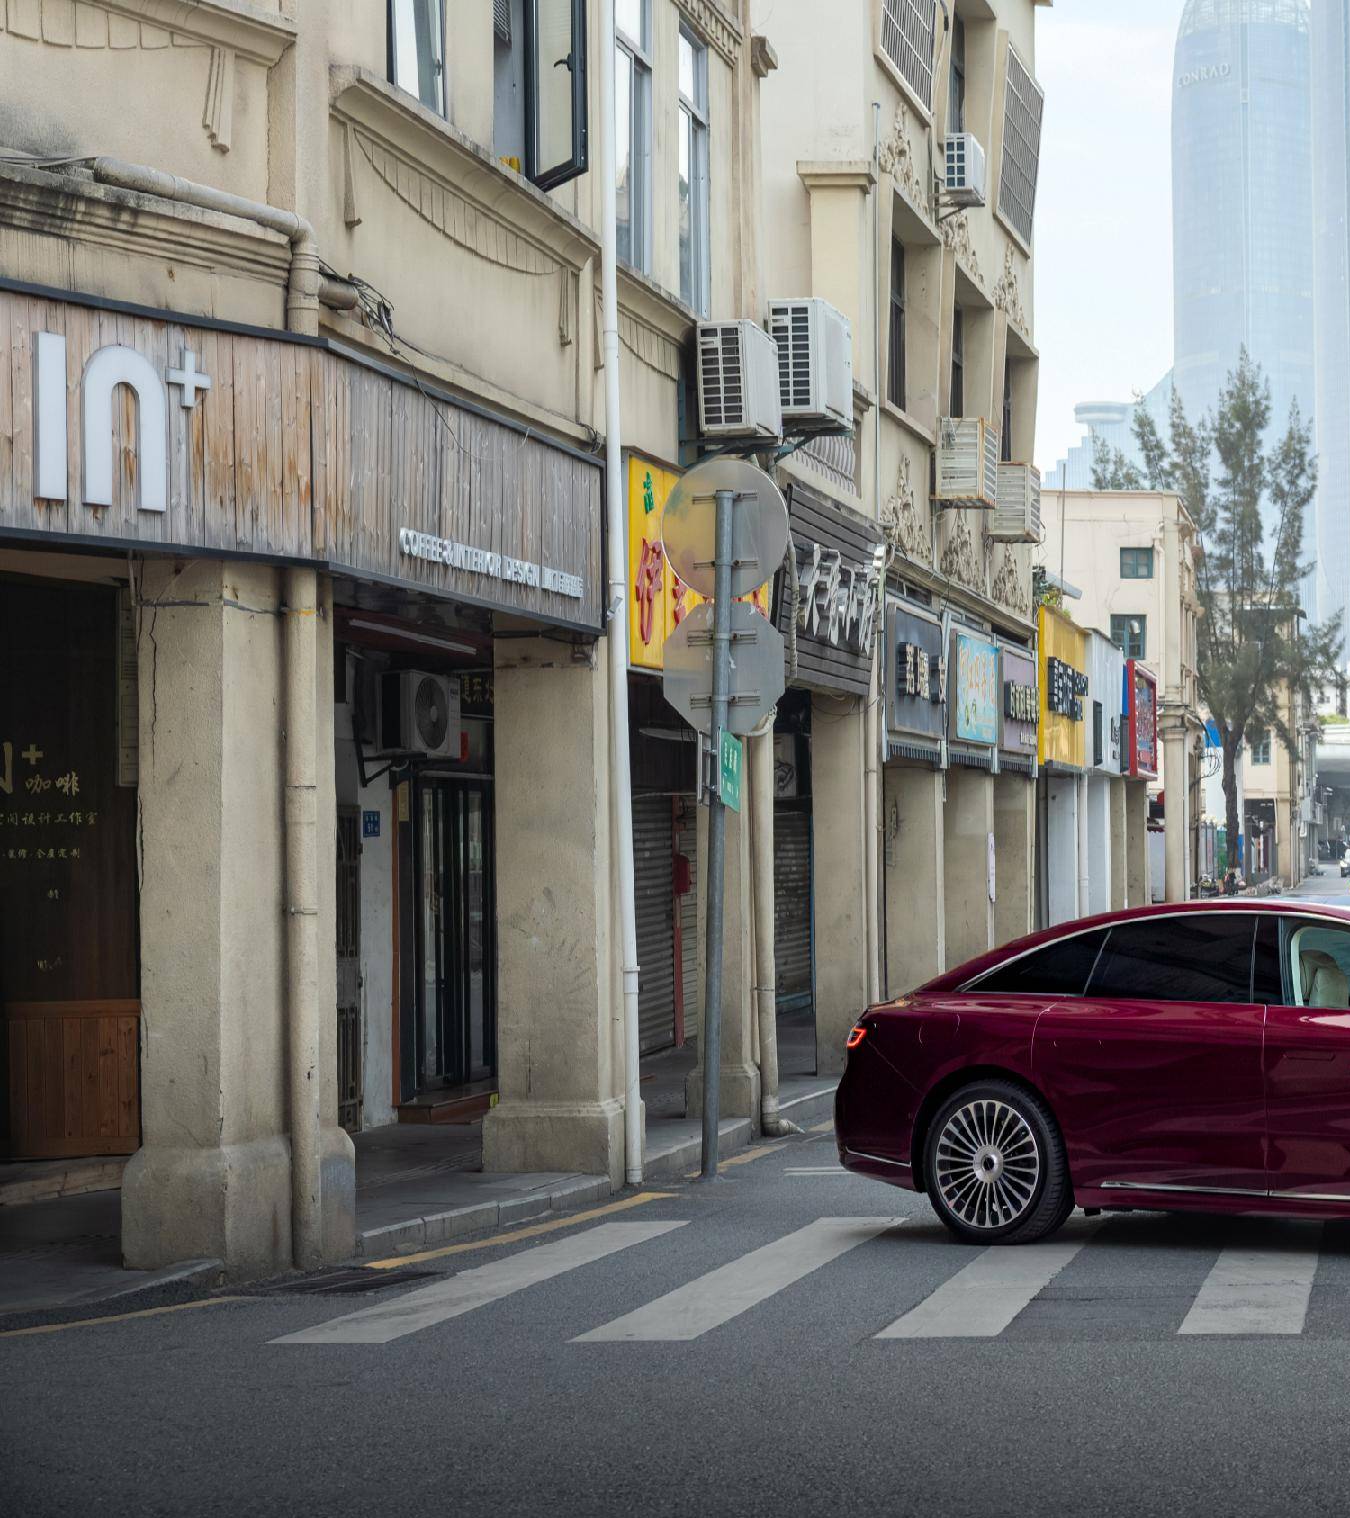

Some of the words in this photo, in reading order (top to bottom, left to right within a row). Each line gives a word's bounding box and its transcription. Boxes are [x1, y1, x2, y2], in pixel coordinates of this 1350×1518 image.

[1176, 63, 1231, 88] CONRAD
[502, 555, 540, 588] DESIGN
[25, 771, 80, 797] 咖啡
